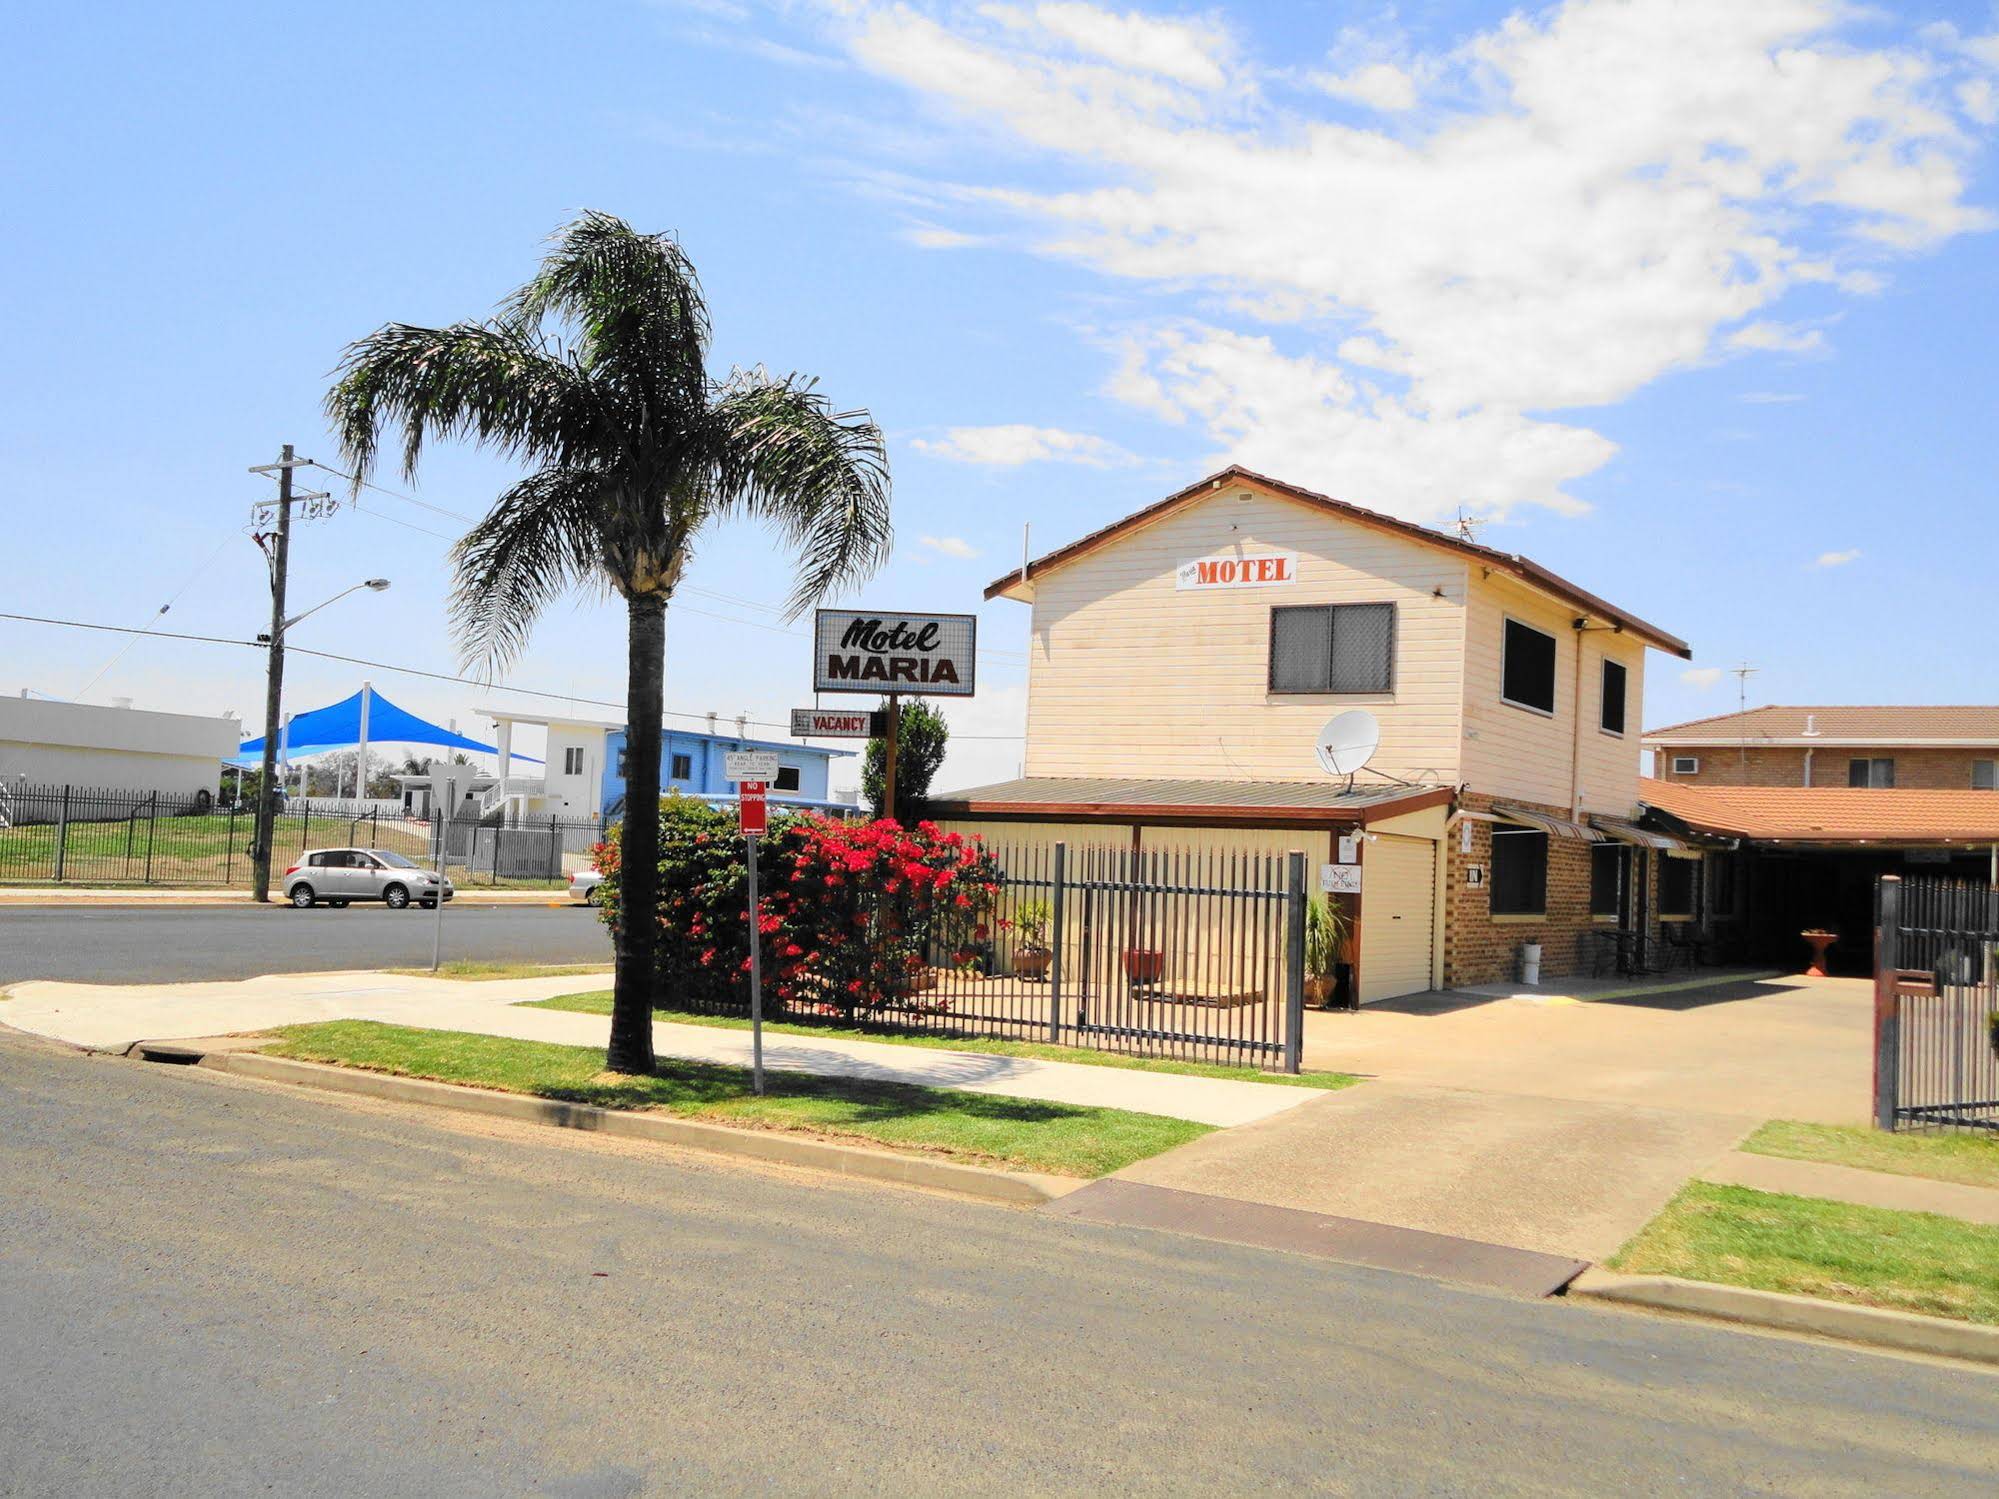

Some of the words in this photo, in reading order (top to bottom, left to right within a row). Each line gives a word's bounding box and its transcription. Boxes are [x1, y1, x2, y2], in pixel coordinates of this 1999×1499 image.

[1196, 558, 1292, 585] MOTEL
[840, 617, 941, 654] Motel
[828, 654, 960, 684] MARIA
[812, 716, 866, 732] VACANCY
[747, 782, 758, 790] NO
[741, 793, 766, 802] STOPPING
[1469, 869, 1478, 882] IN
